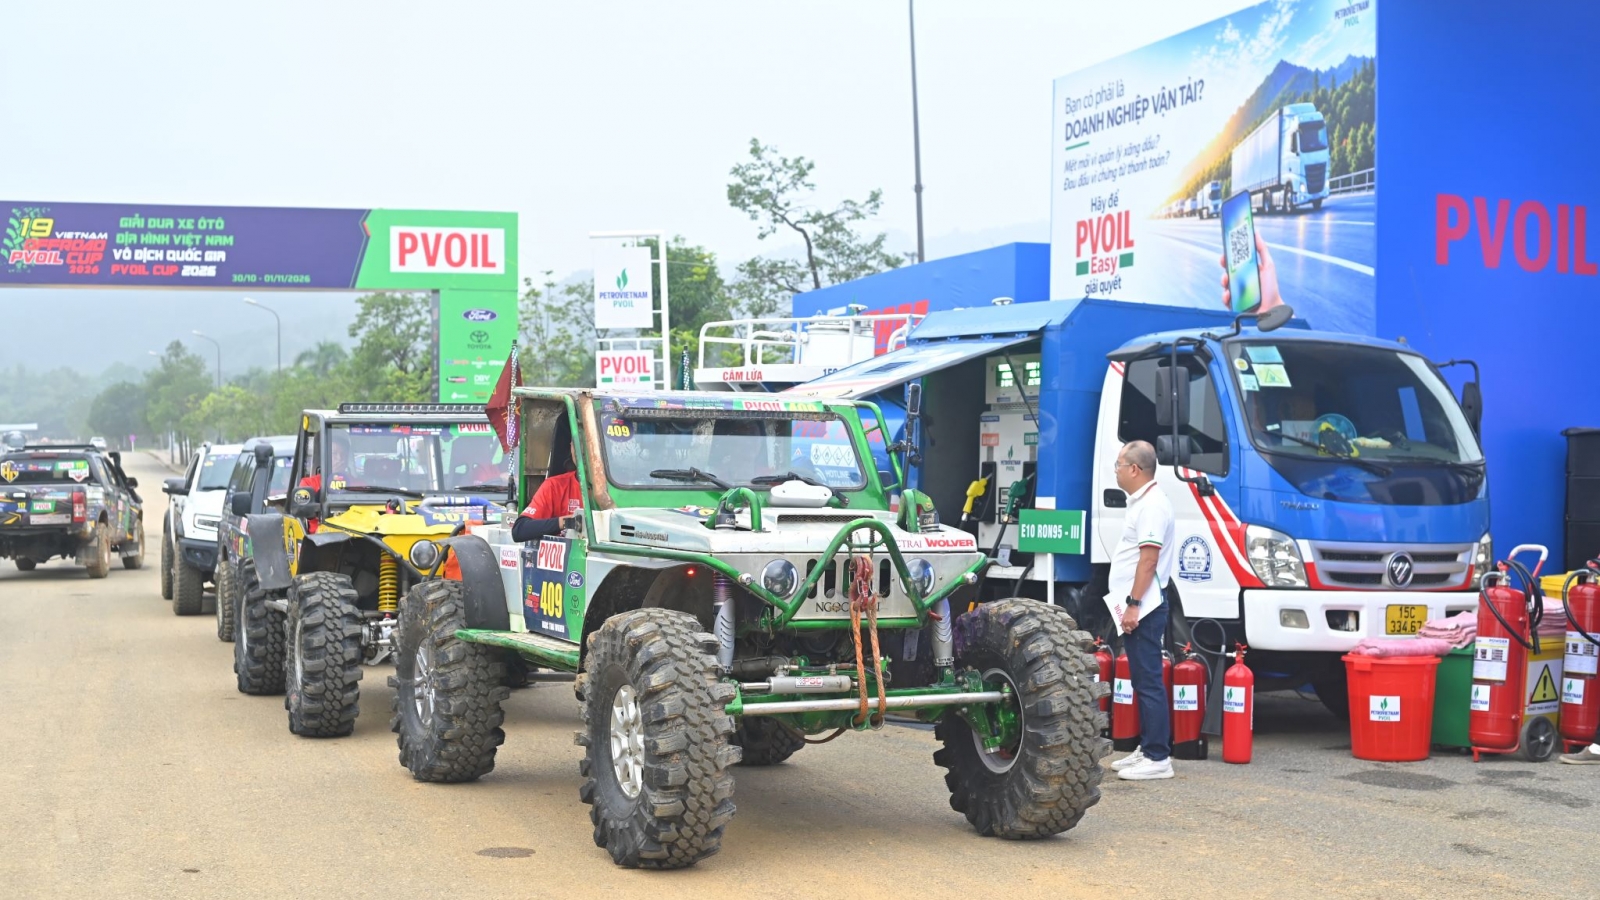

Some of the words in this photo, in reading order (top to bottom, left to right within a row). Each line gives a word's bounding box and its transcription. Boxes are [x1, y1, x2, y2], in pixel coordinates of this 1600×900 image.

[1066, 97, 1081, 116] Bạn
[1083, 89, 1094, 108] có
[1096, 82, 1114, 110] phải
[1116, 79, 1124, 98] là
[1065, 112, 1104, 142] DOANH
[1107, 94, 1150, 128] NGHIỆP
[1152, 86, 1176, 117] VẬN
[1179, 76, 1204, 106] TẢI?
[1091, 196, 1106, 213] Hãy
[1108, 188, 1120, 208] để
[20, 218, 54, 238] 19
[55, 232, 108, 240] VIETNAM
[178, 218, 194, 230] XE
[205, 235, 234, 246] NAM
[1076, 210, 1134, 258] PVOIL
[1435, 193, 1598, 276] PVOIL
[112, 246, 132, 260] VÔ
[166, 247, 202, 262] QUỐC
[204, 250, 226, 262] GIA
[398, 232, 496, 268] PVOIL
[9, 251, 63, 265] PVOIL
[66, 252, 104, 264] CUP
[69, 265, 99, 274] 2026
[111, 264, 149, 276] PVOIL
[152, 264, 178, 276] CUP
[181, 265, 216, 276] 2026
[1091, 256, 1118, 276] Easy
[232, 274, 257, 282] 30/10
[264, 274, 310, 283] 01/11/2026
[1085, 279, 1098, 298] giải
[1100, 274, 1122, 295] quyết
[613, 300, 634, 308] PVOIL
[468, 310, 492, 320] Ford
[600, 356, 650, 374] PVOIL
[614, 376, 637, 384] Easy
[460, 424, 490, 432] PVOIL
[606, 425, 631, 438] 409
[1021, 524, 1036, 538] E10
[1038, 524, 1062, 538] RON95
[1070, 524, 1080, 539] III
[925, 537, 974, 547] WOLVER
[538, 542, 564, 570] PVOIL
[570, 573, 582, 586] Ford
[540, 581, 562, 618] 409
[1400, 606, 1416, 618] 15C
[1390, 620, 1422, 632] 334.67
